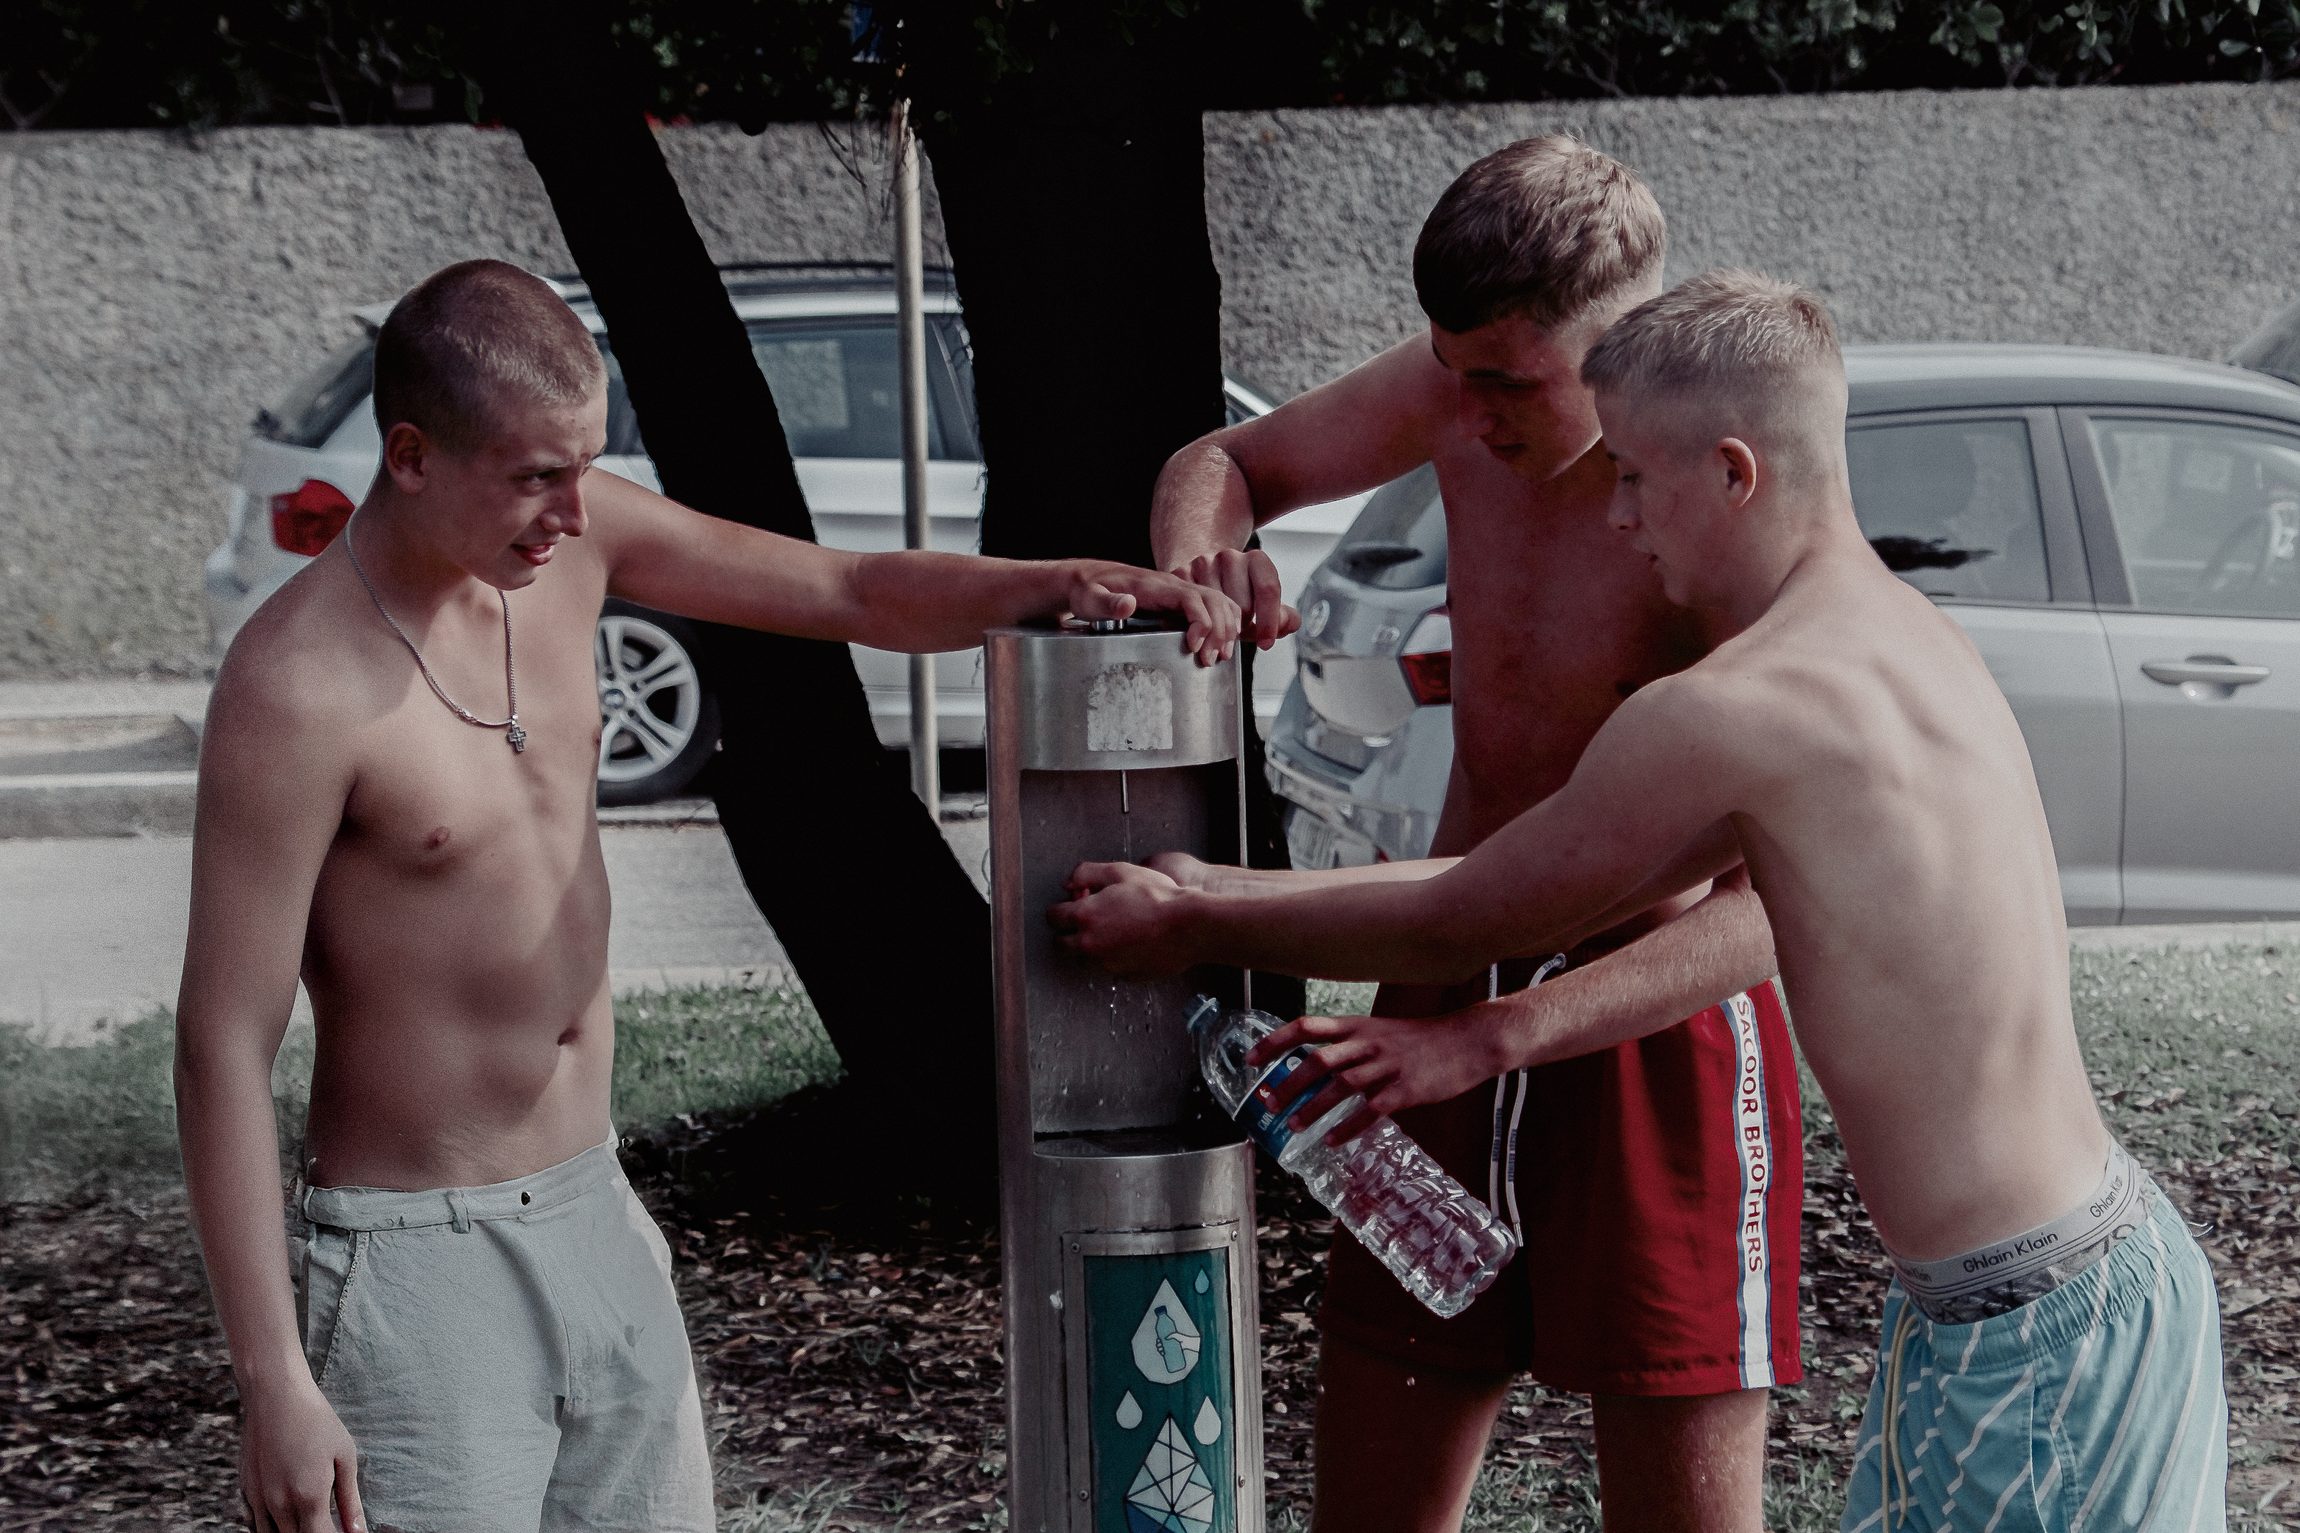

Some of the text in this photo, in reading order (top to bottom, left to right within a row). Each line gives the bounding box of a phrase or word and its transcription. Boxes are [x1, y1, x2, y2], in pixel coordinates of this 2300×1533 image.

[1737, 1000, 1766, 1273] SACOOR BROTHERS
[2089, 1190, 2117, 1218] Ghlain
[1963, 1231, 2058, 1273] Ghlain Klain
